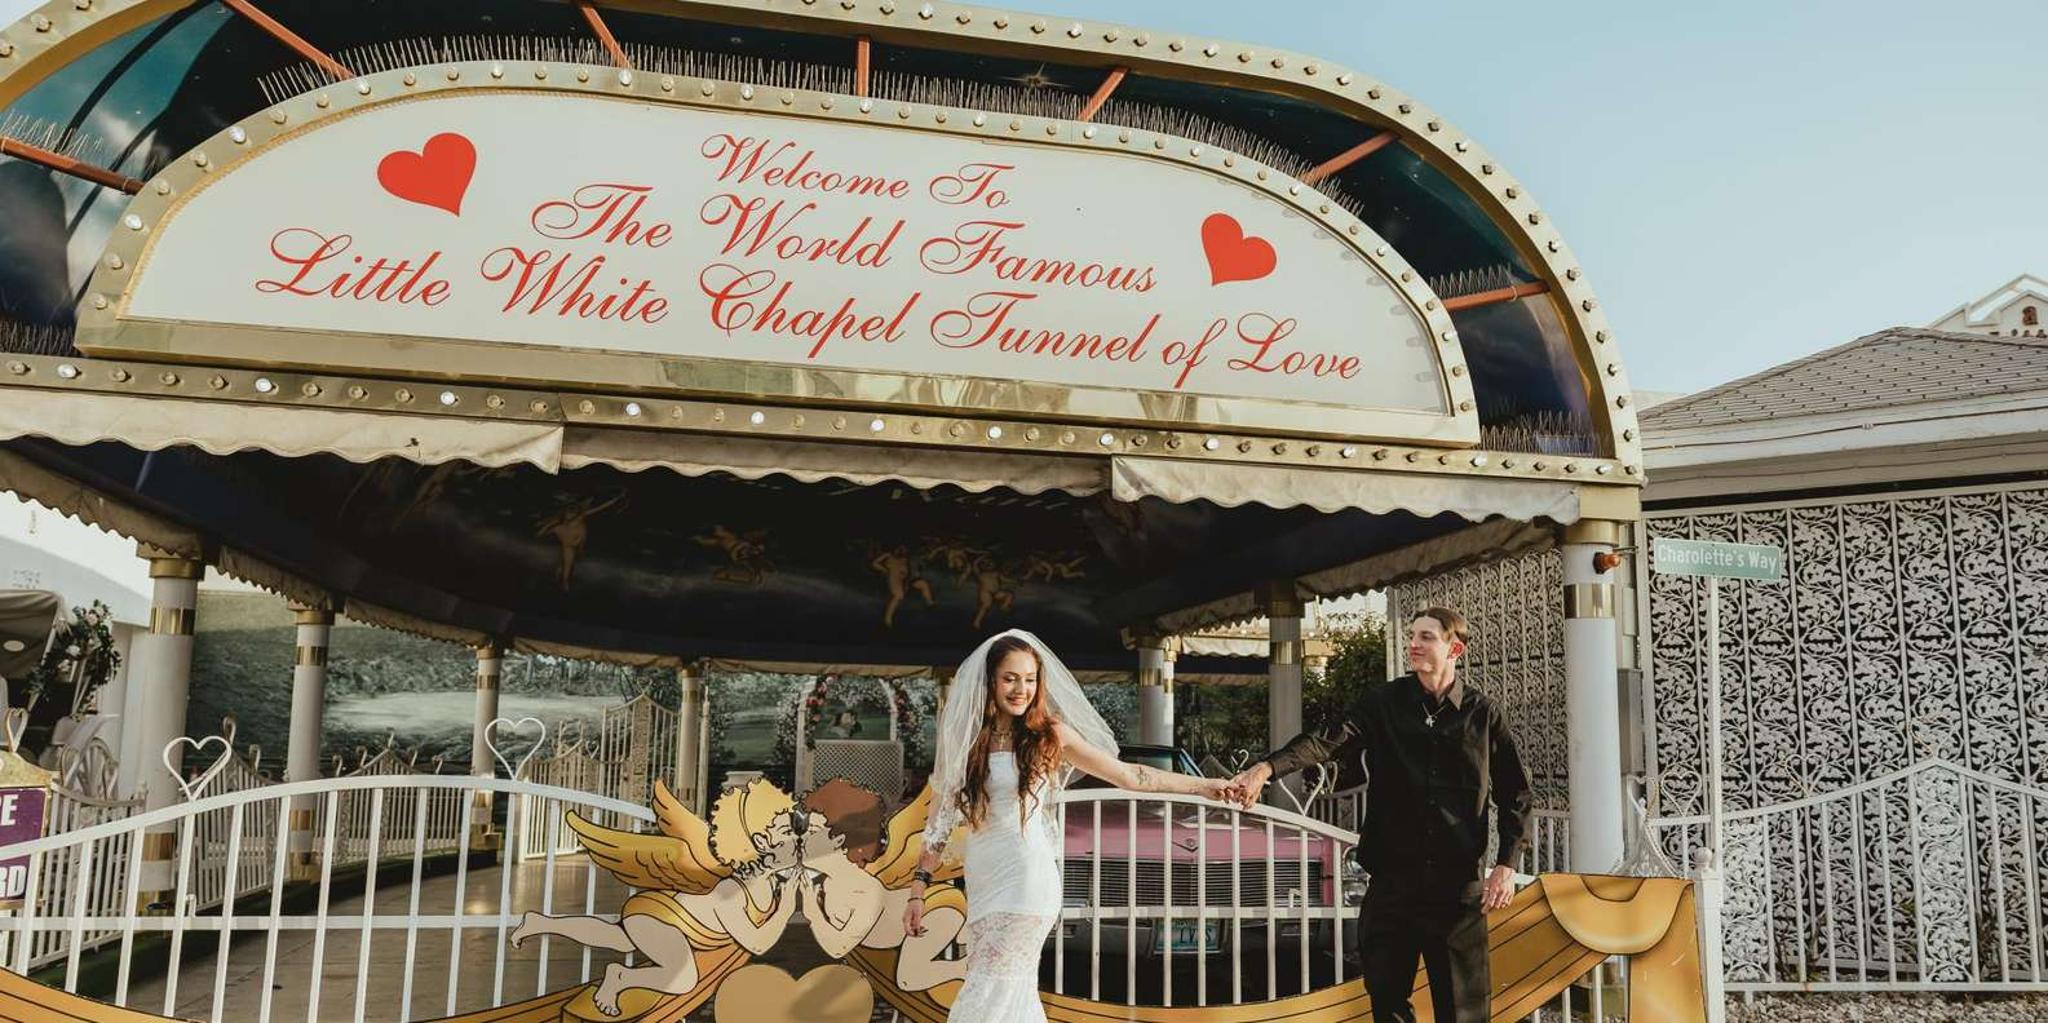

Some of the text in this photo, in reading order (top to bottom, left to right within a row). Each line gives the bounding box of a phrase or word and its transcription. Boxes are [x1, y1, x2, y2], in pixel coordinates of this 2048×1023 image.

[701, 133, 1015, 209] Welcome To
[532, 183, 1158, 293] The World Famous
[255, 227, 1362, 389] Little White Chapel Tunnel of Love
[1657, 544, 1778, 574] Charolette's Way
[0, 793, 19, 826] E
